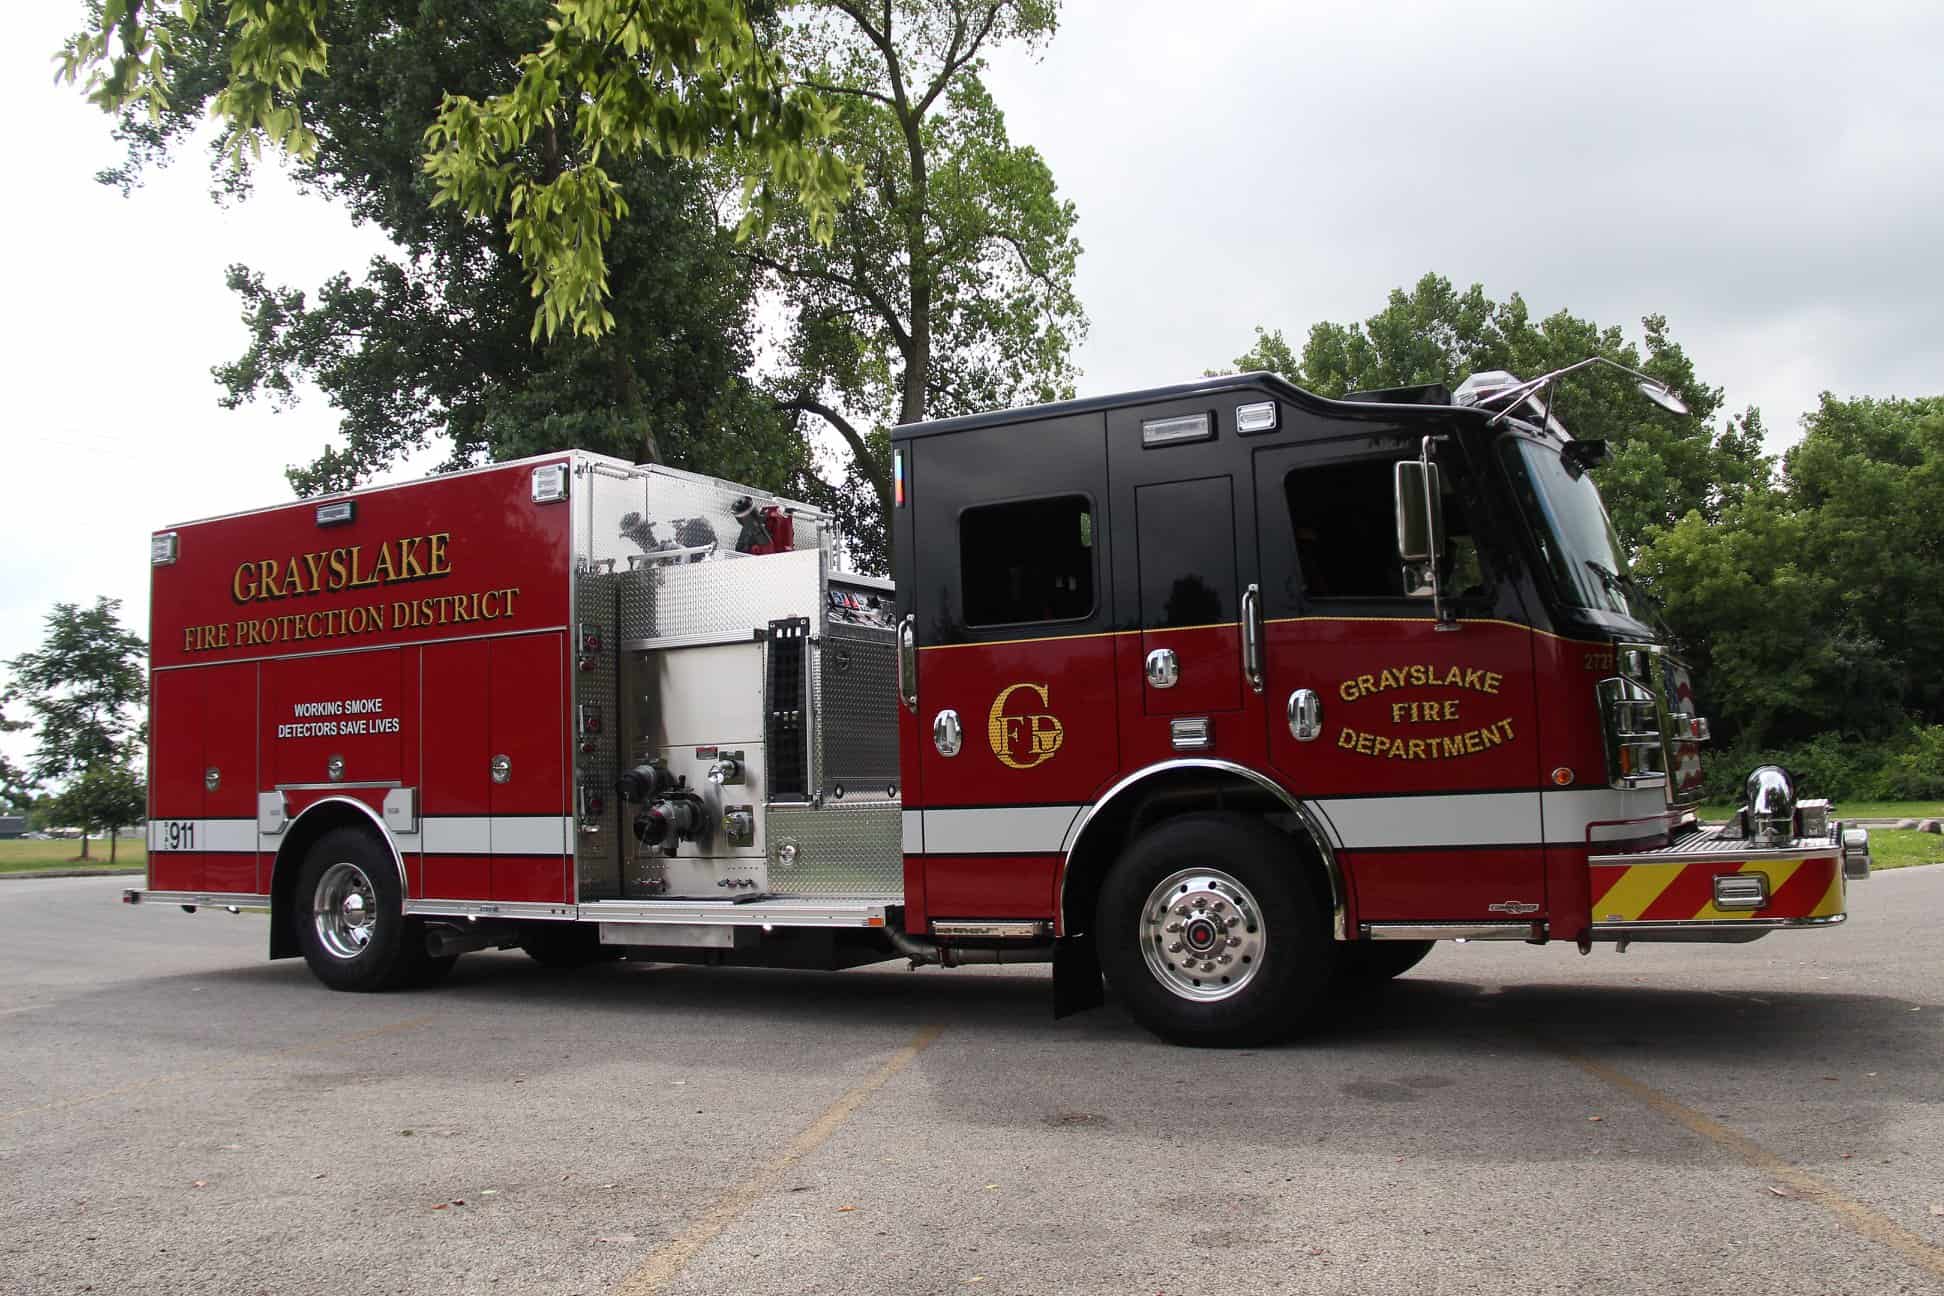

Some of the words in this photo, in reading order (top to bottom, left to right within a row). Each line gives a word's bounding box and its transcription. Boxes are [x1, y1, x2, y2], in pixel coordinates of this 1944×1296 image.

[233, 532, 452, 602] GRAYSLAKE
[184, 623, 230, 651] FIRE
[235, 604, 386, 645] PROTECTION
[391, 588, 520, 629] DISTRICT
[1339, 664, 1503, 702] GRAYSLAKE
[294, 701, 343, 718] WORKING
[344, 698, 383, 714] SMOKE
[1391, 700, 1460, 723] FIRE
[277, 722, 338, 738] DETECTORS
[340, 720, 367, 735] SAVE
[369, 718, 400, 733] LIVES
[1337, 717, 1515, 760] DEPARTMENT
[170, 821, 194, 850] 911
